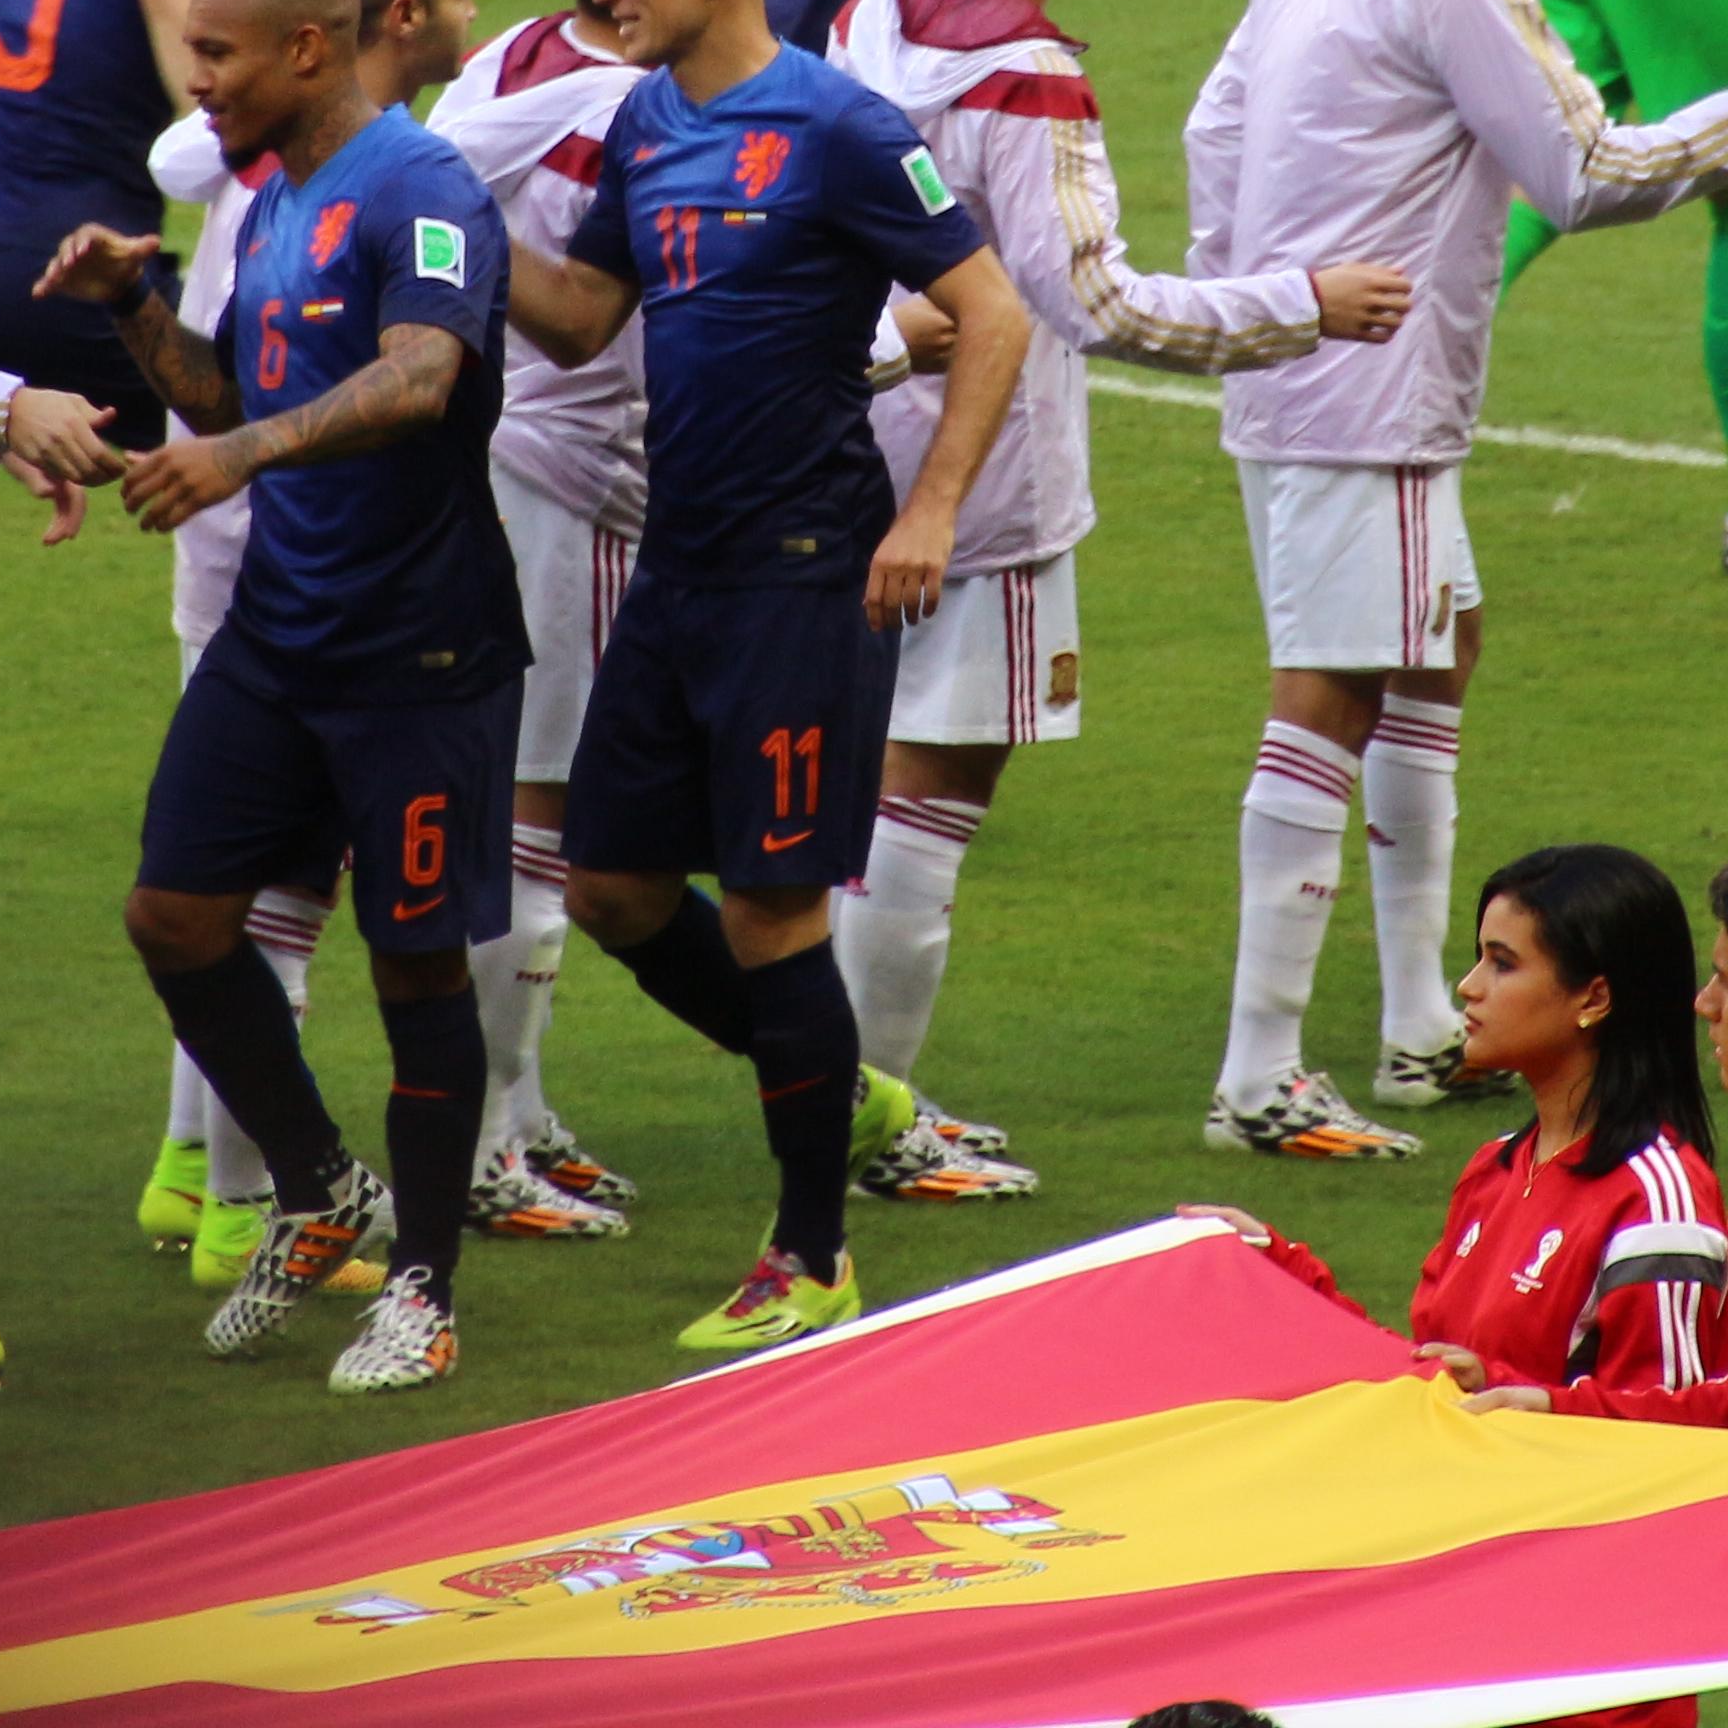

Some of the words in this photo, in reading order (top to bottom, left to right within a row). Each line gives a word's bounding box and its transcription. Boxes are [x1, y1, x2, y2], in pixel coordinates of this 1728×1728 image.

[655, 205, 701, 290] 11
[257, 298, 289, 391] 6
[759, 725, 824, 820] 11
[400, 792, 449, 888] 6
